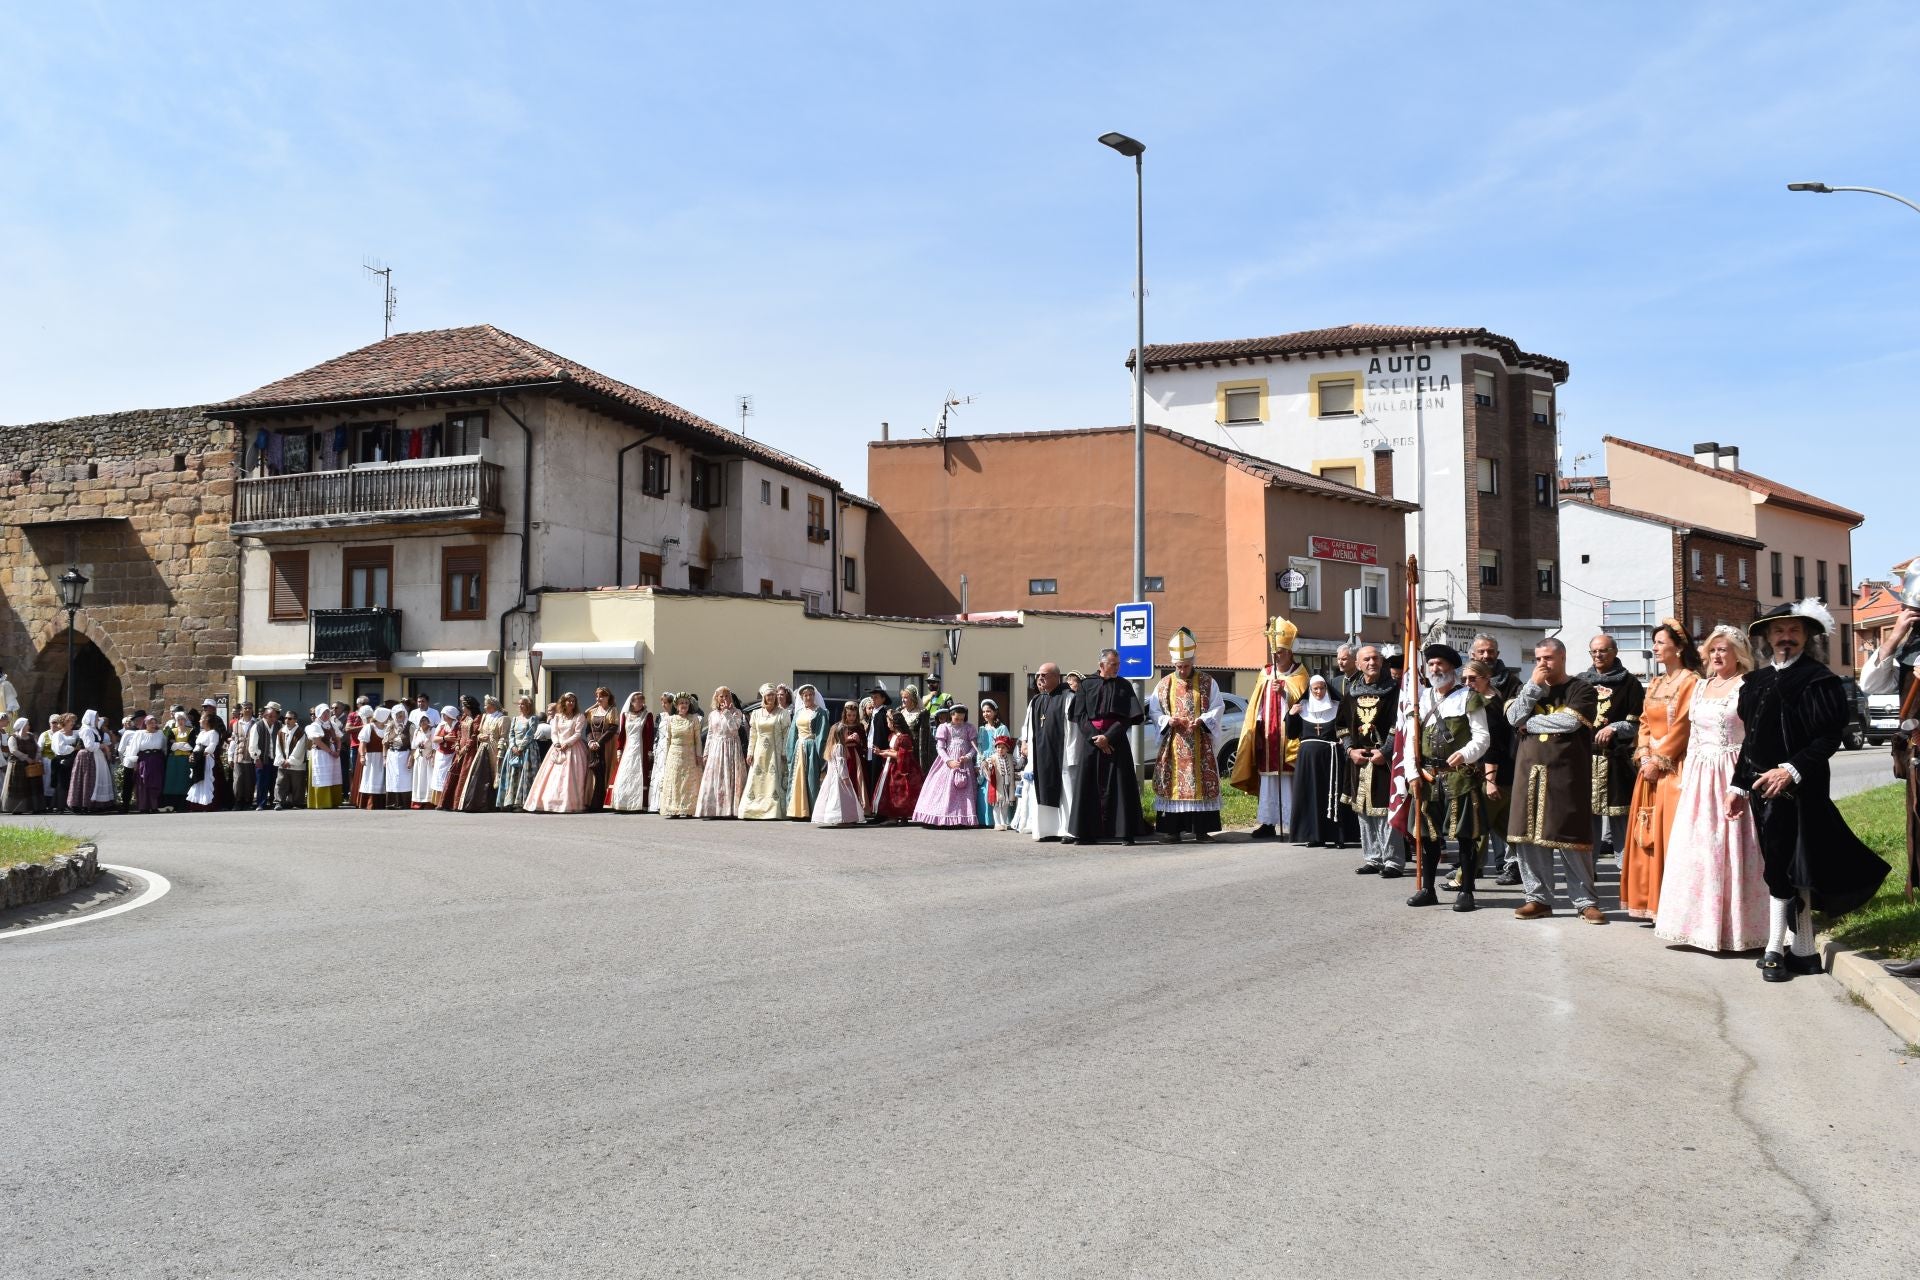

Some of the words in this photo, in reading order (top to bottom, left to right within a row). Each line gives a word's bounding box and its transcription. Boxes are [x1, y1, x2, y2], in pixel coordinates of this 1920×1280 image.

[1368, 355, 1431, 374] AUTO
[1368, 375, 1450, 396] ESCUELA
[1332, 549, 1358, 560] AVENIDA
[1346, 543, 1358, 551] BAR
